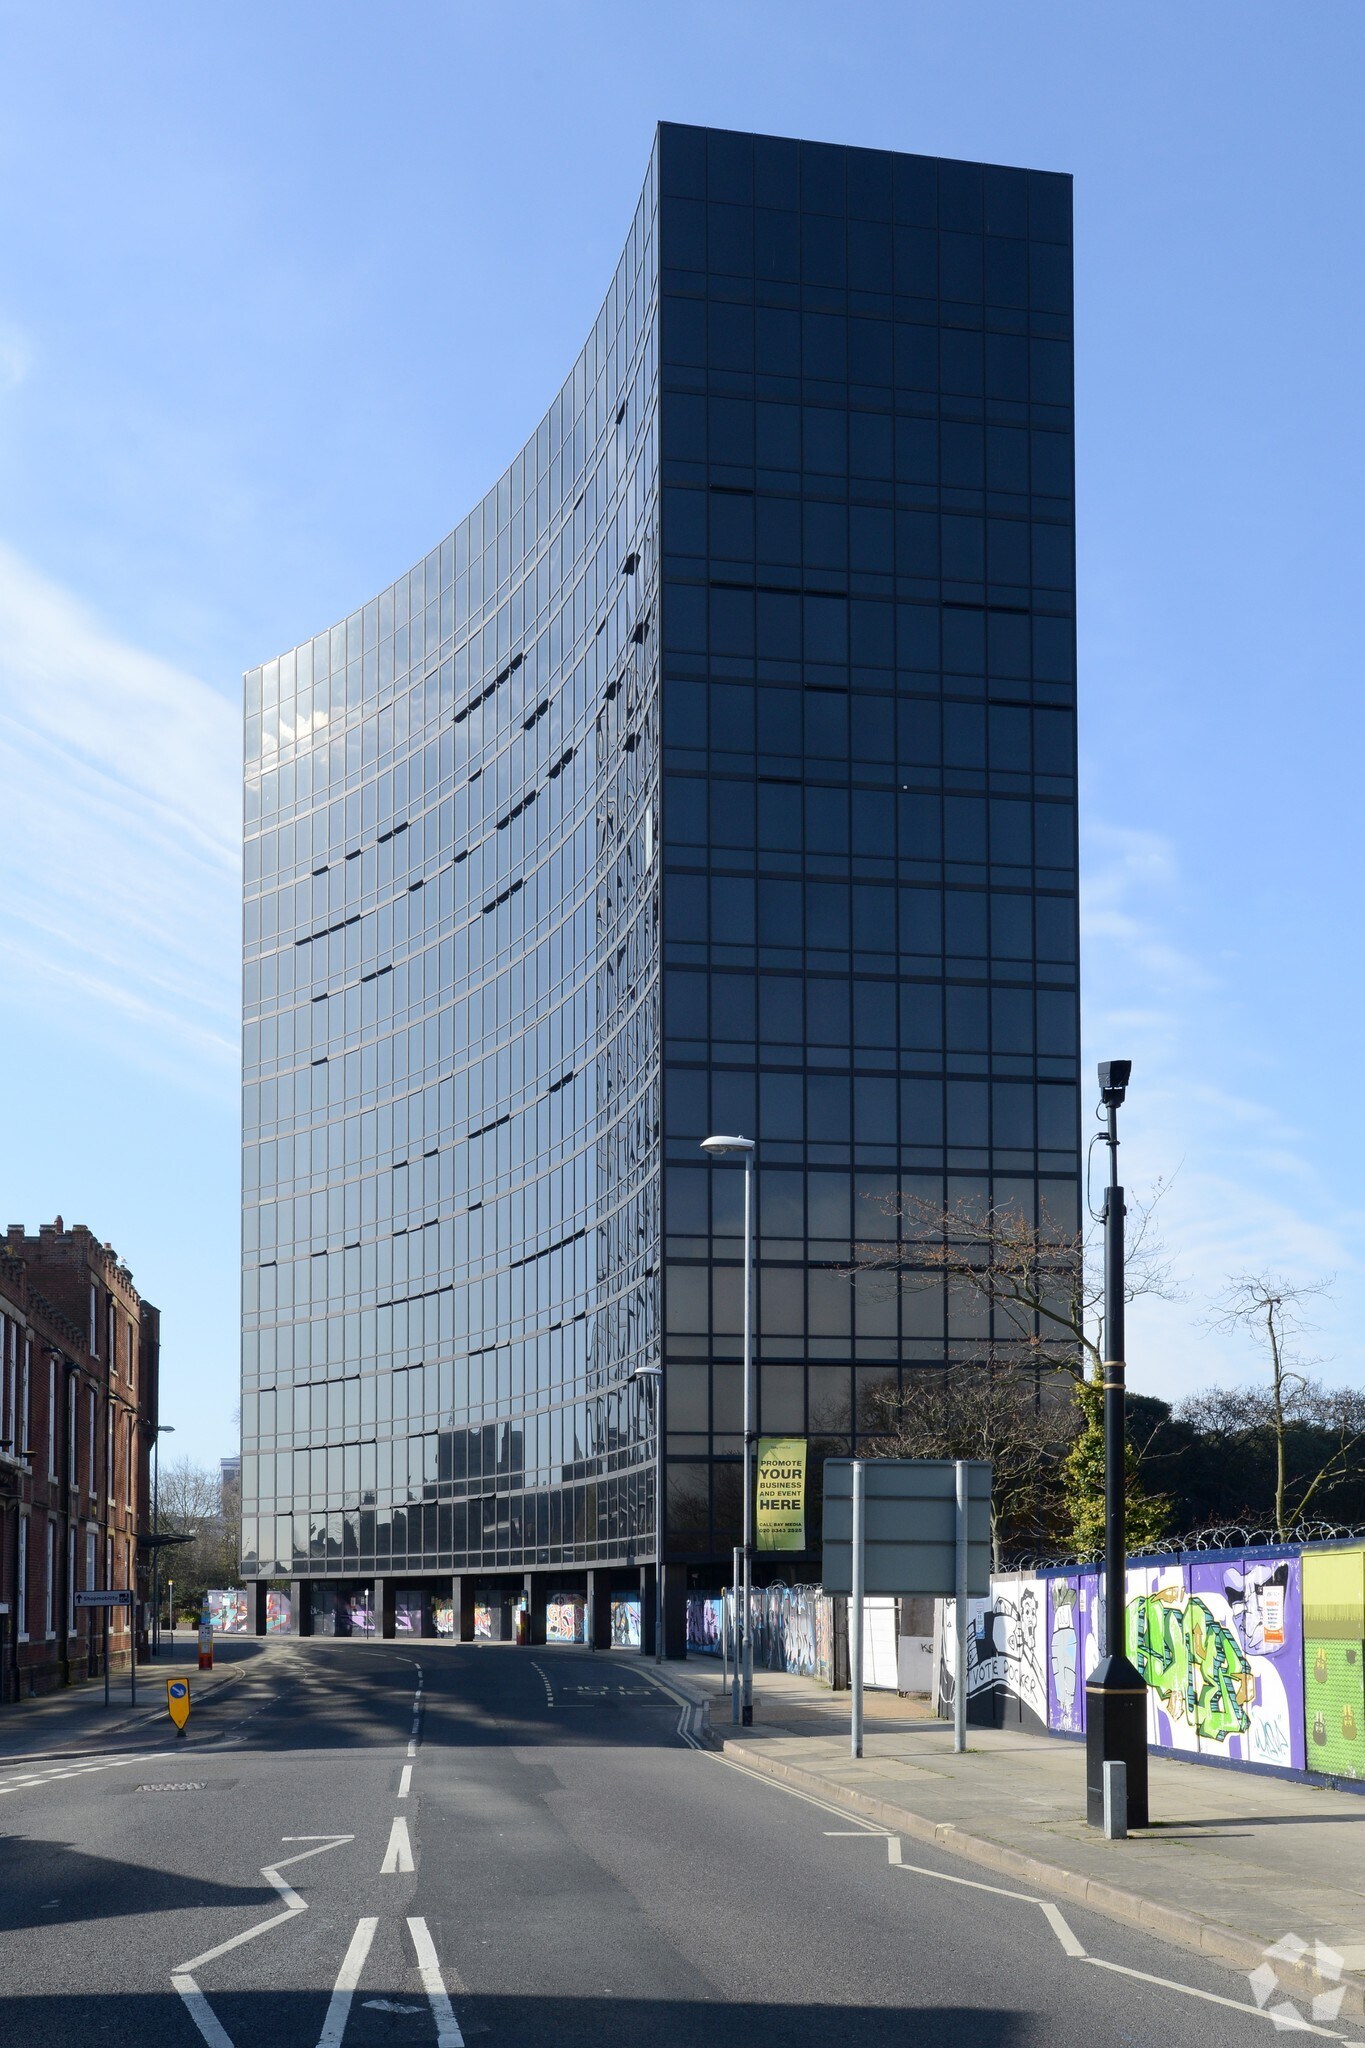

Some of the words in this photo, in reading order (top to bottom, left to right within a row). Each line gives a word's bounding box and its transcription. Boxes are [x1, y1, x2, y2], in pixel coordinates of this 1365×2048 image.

[760, 1468, 802, 1479] YOUR
[760, 1500, 801, 1510] HERE
[973, 1660, 998, 1685] VOTE
